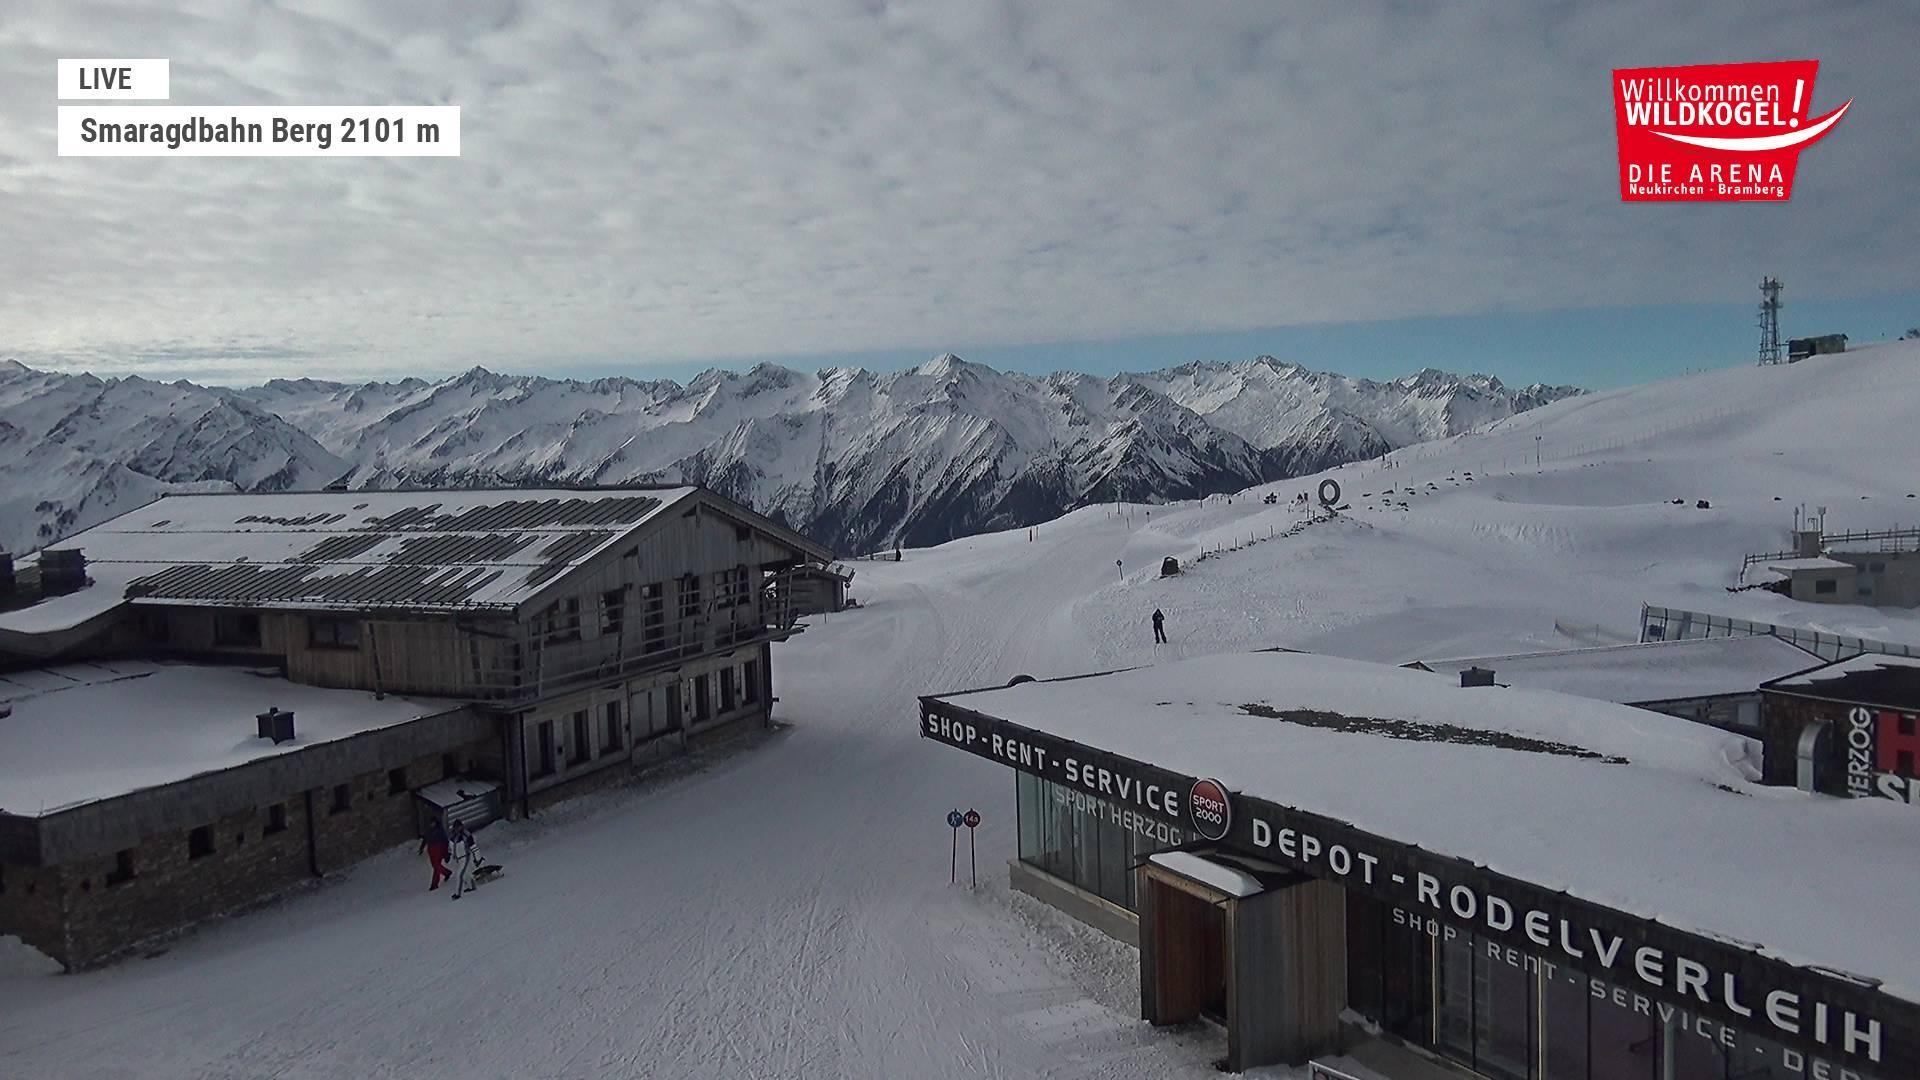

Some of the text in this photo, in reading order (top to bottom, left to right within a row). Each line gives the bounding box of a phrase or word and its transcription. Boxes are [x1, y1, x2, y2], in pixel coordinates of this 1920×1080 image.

[1055, 787, 1182, 847] SPORT HERZOG
[1193, 794, 1225, 813] SPORT
[1196, 807, 1222, 825] 2000
[1393, 907, 1457, 942] SHOP
[1487, 940, 1557, 980] RENT
[1590, 979, 1737, 1048] SERVICE
